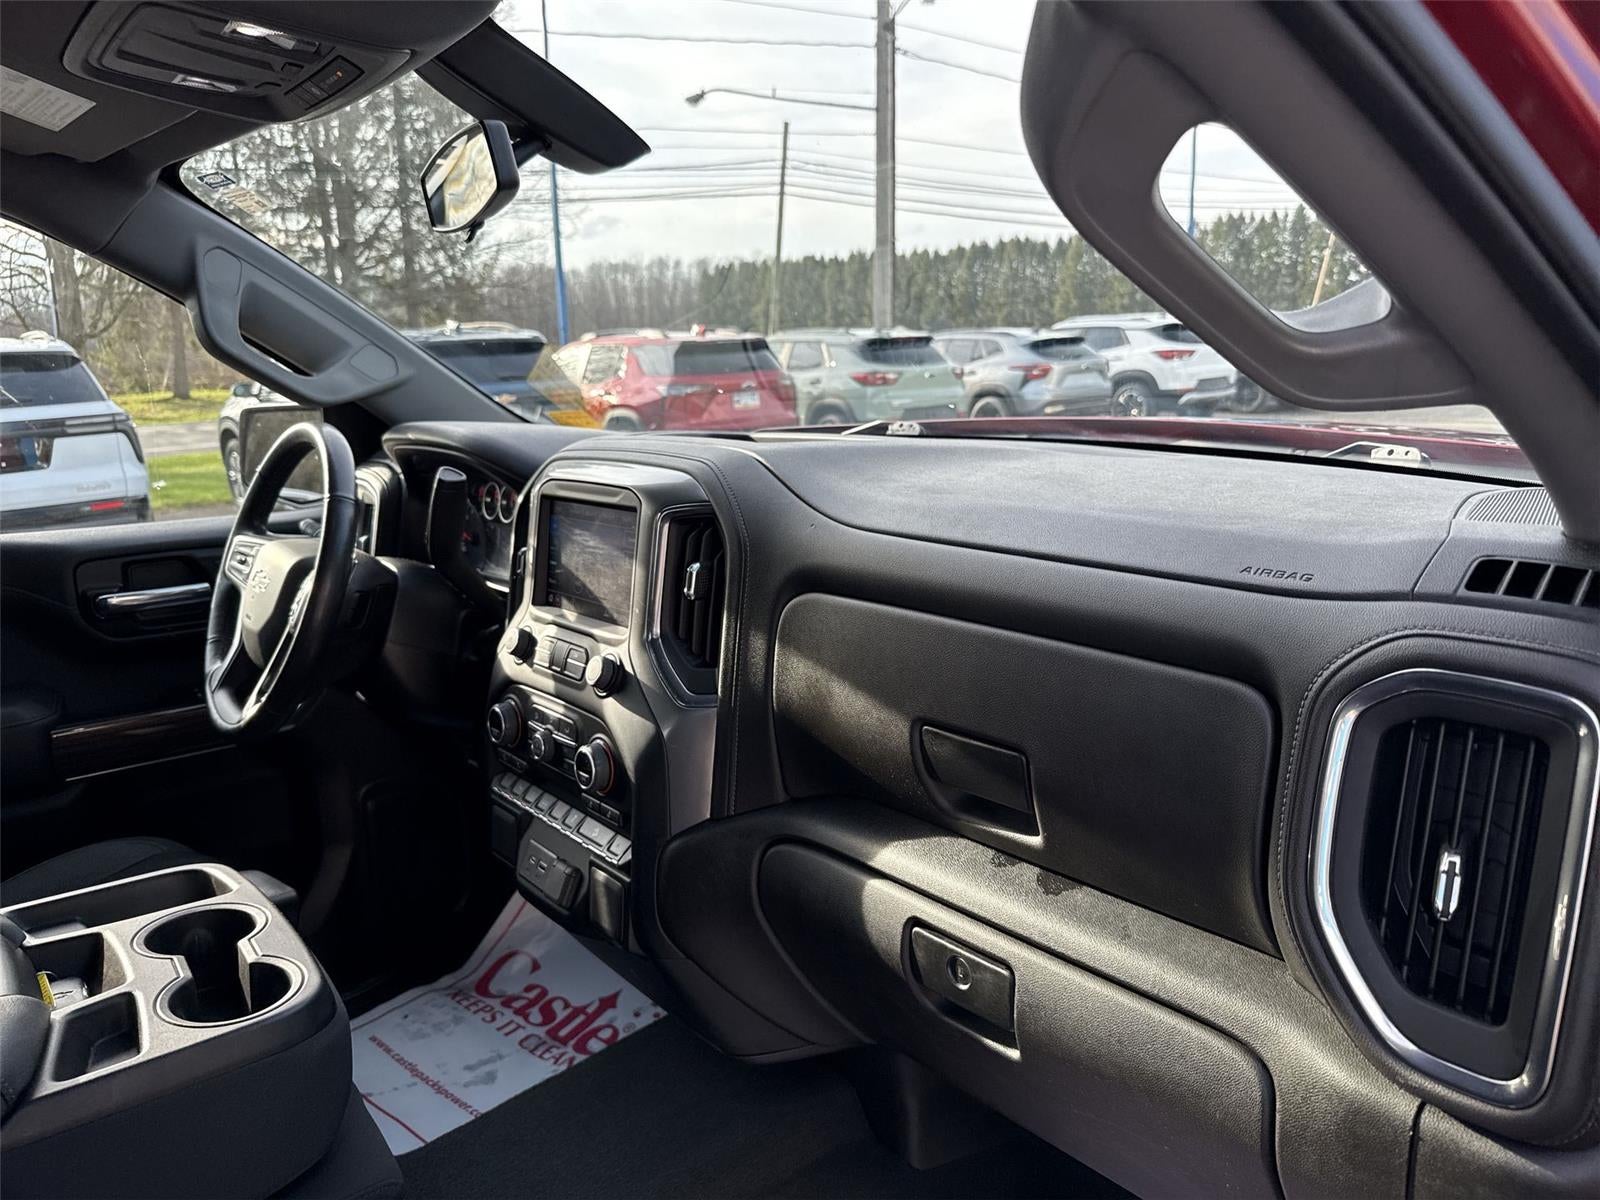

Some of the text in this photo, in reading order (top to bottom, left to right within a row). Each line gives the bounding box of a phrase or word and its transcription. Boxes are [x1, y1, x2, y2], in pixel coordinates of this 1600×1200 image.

[1239, 566, 1314, 582] AIRBAG
[448, 989, 576, 1068] KEEPS IT CLEAN
[475, 949, 622, 1055] Castle
